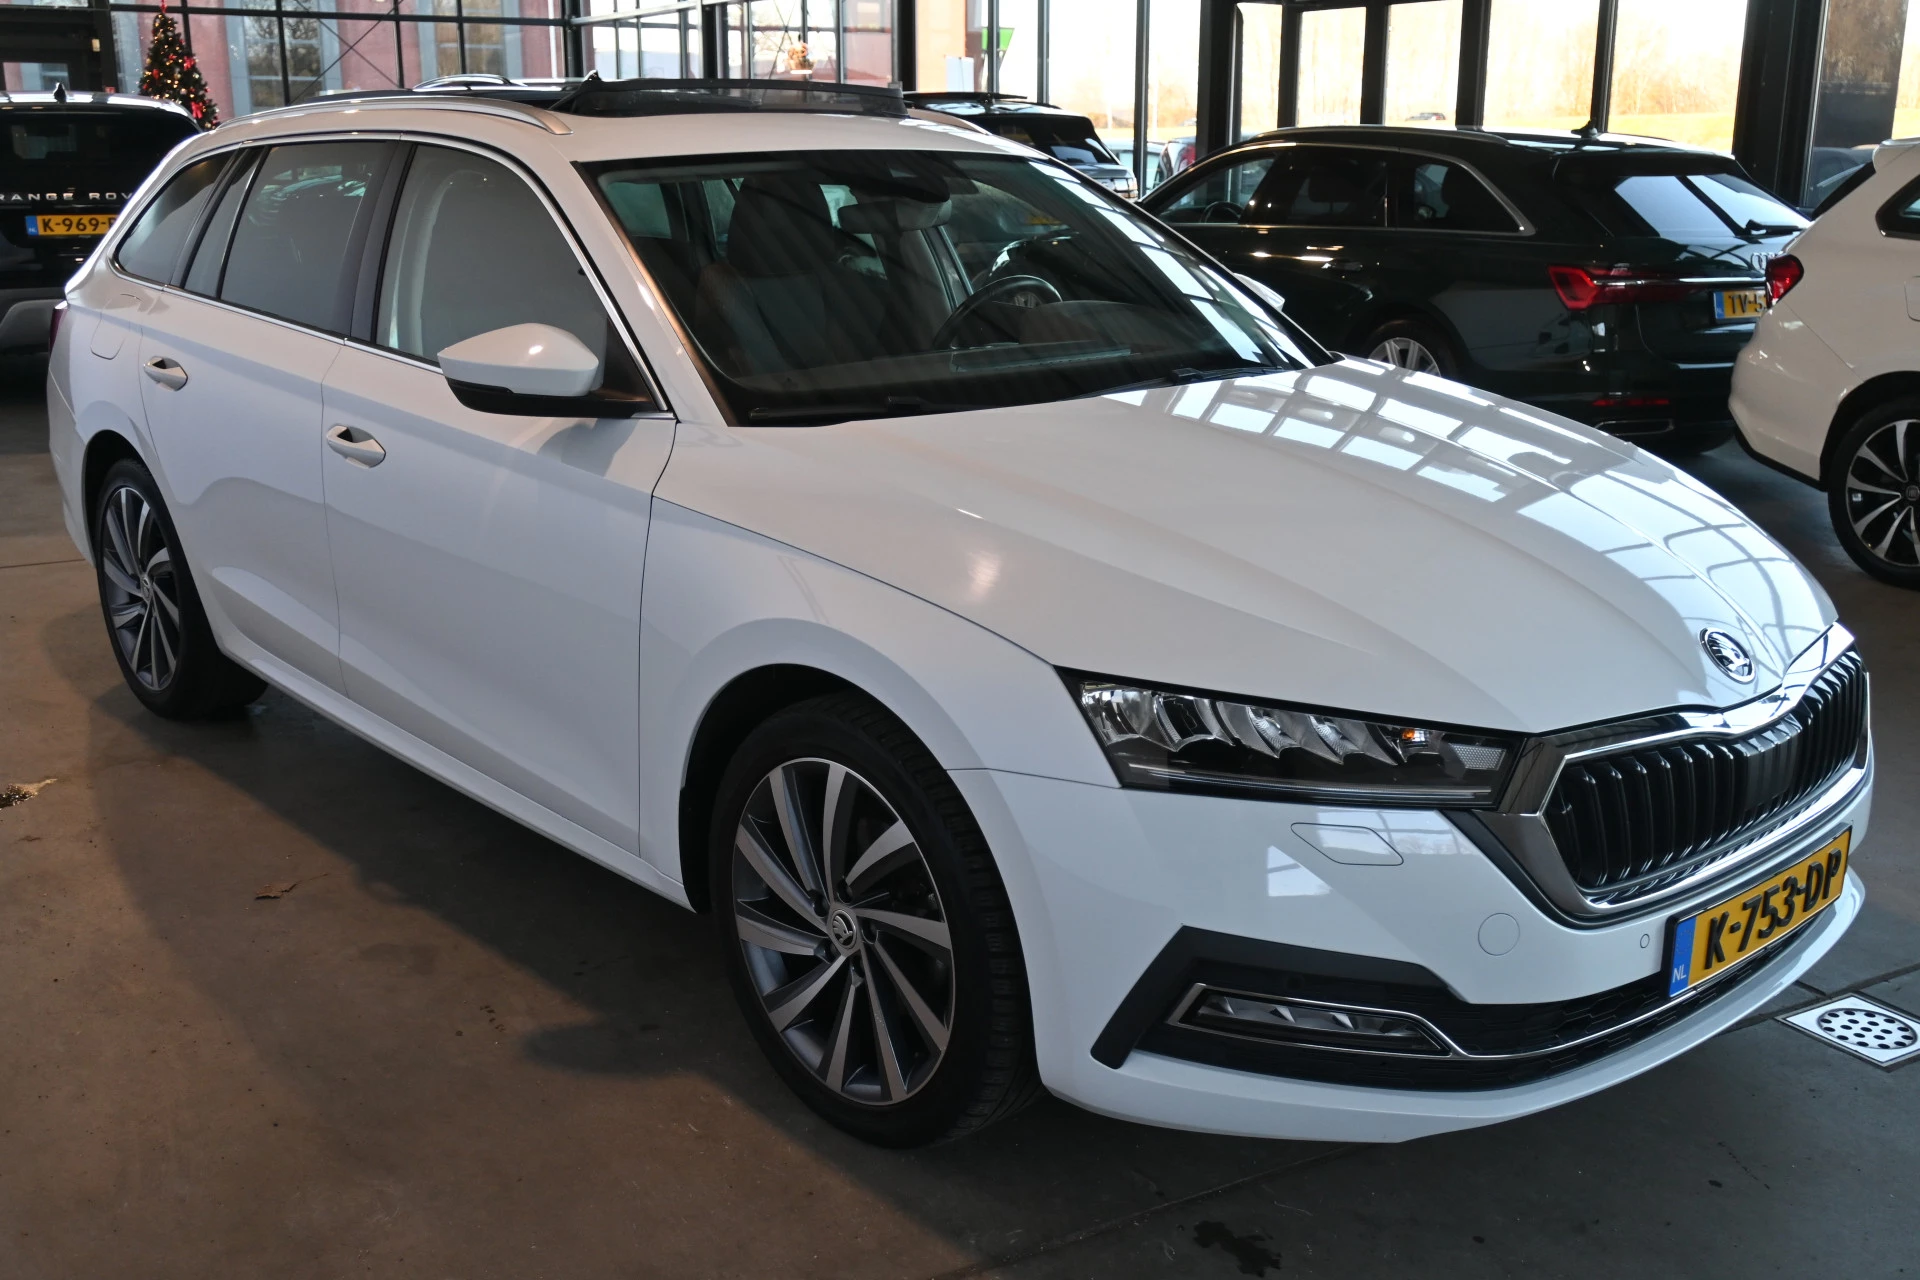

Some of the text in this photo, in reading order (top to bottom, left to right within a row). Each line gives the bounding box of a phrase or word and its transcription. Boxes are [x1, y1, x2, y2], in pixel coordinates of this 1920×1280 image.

[1728, 293, 1767, 314] TV-5
[1704, 848, 1842, 970] K-753-DP
[1672, 964, 1687, 983] NL
